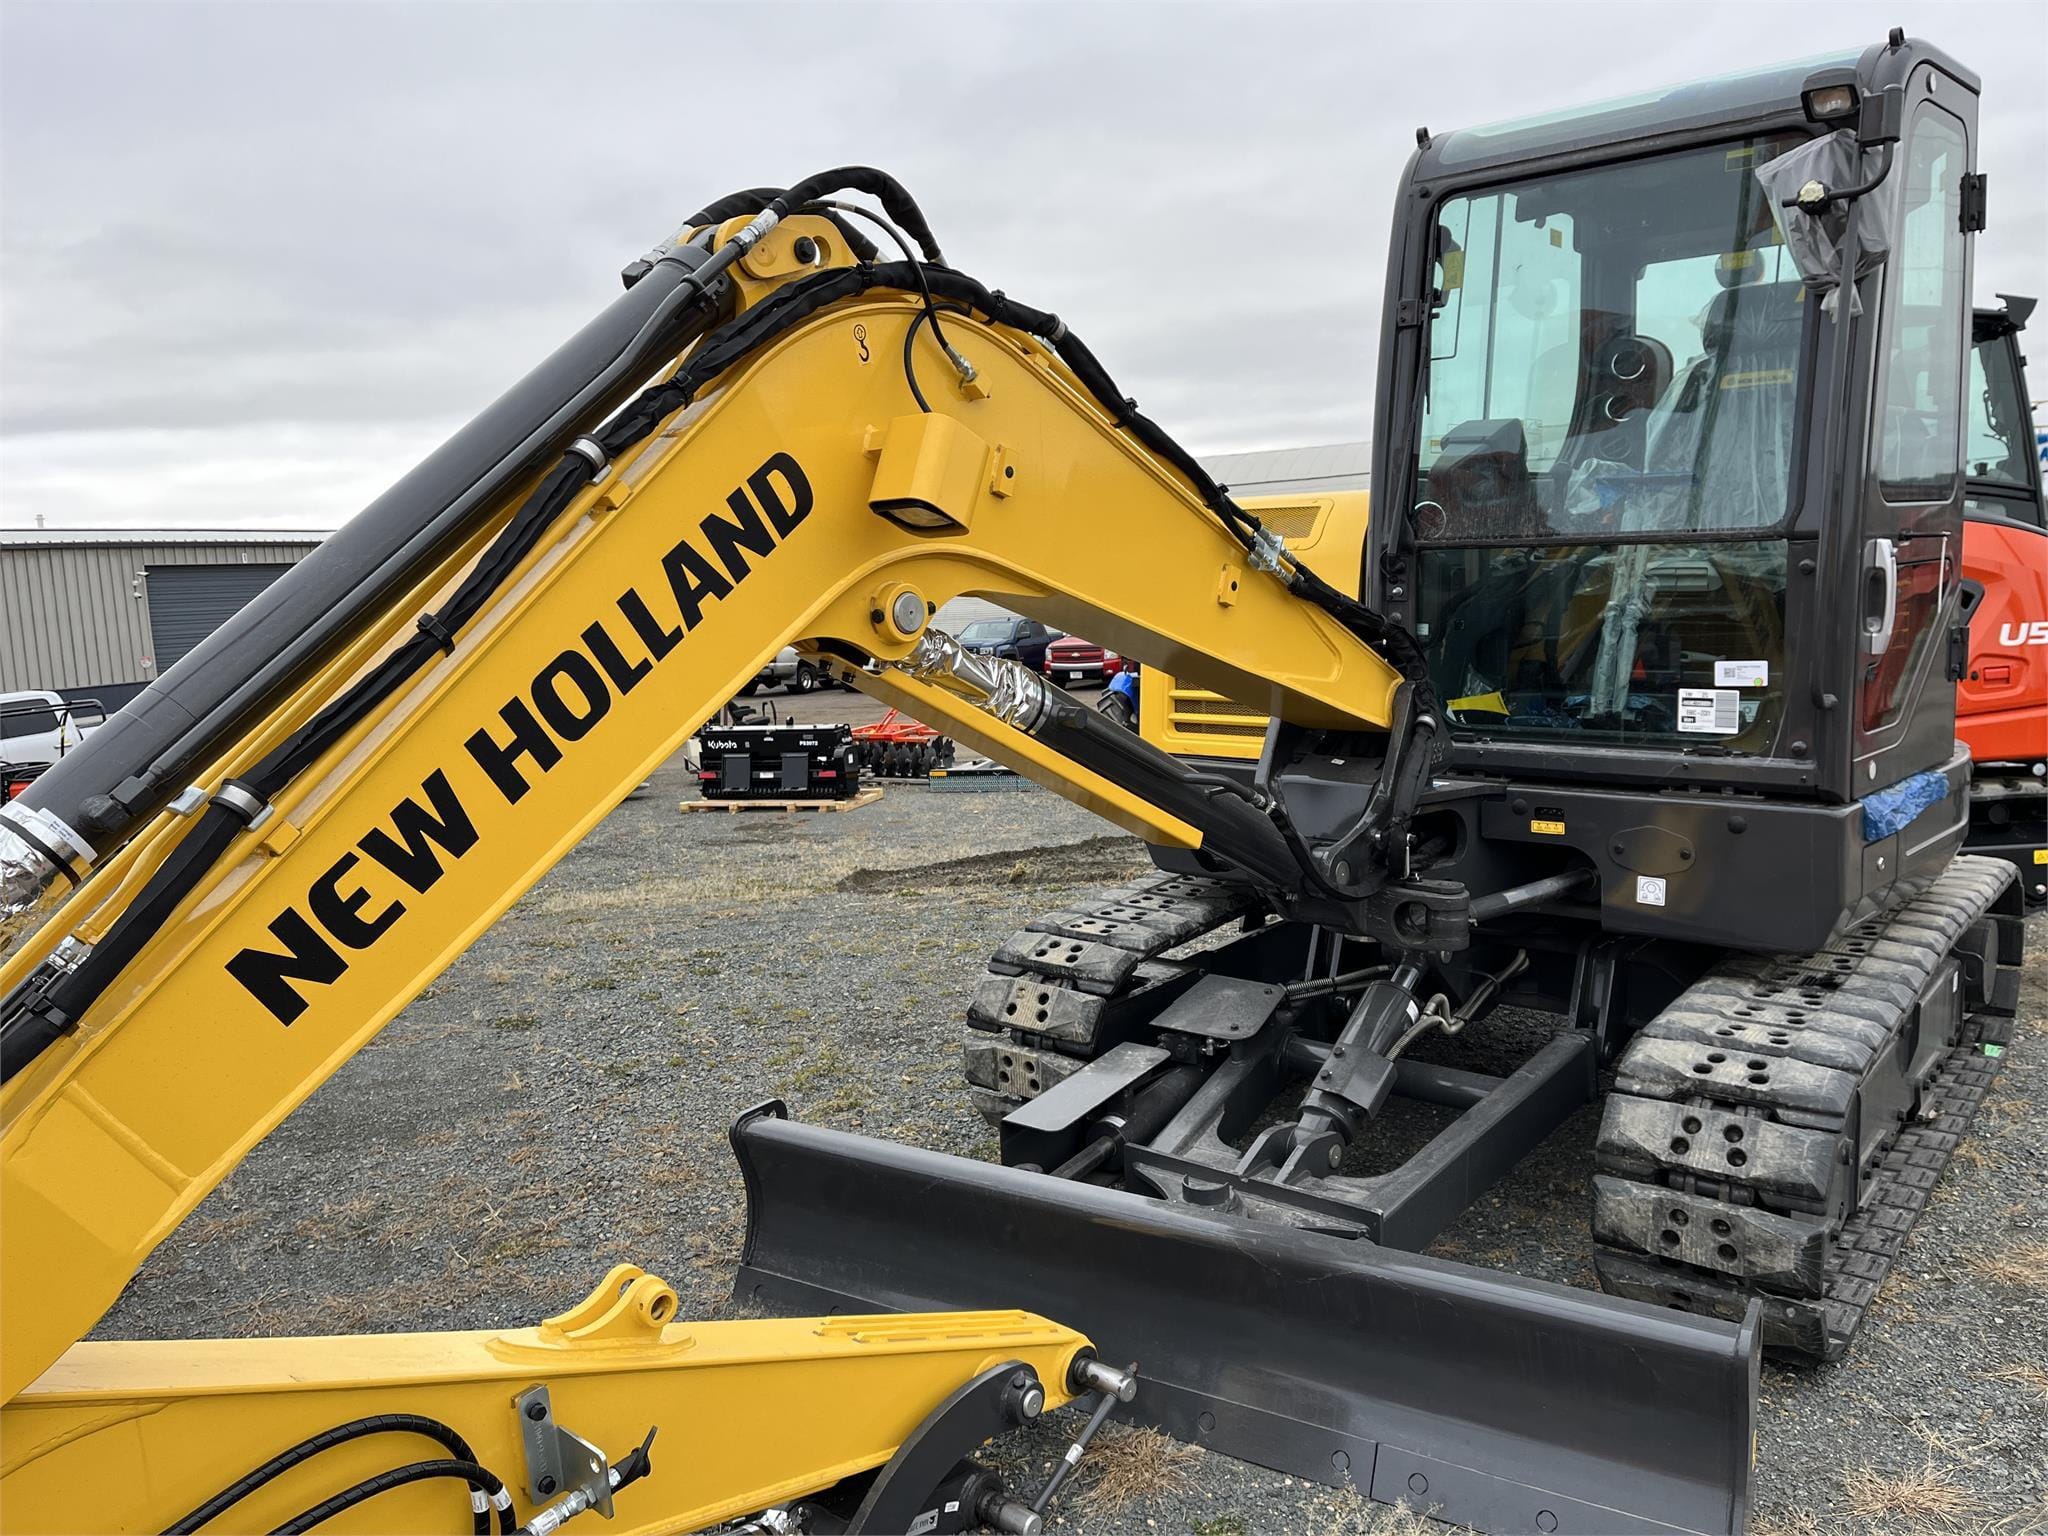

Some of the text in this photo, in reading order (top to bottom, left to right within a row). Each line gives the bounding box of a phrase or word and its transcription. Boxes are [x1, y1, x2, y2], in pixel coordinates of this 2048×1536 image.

[224, 452, 814, 1027] NEW HOLLAND
[707, 740, 738, 750] Kubota
